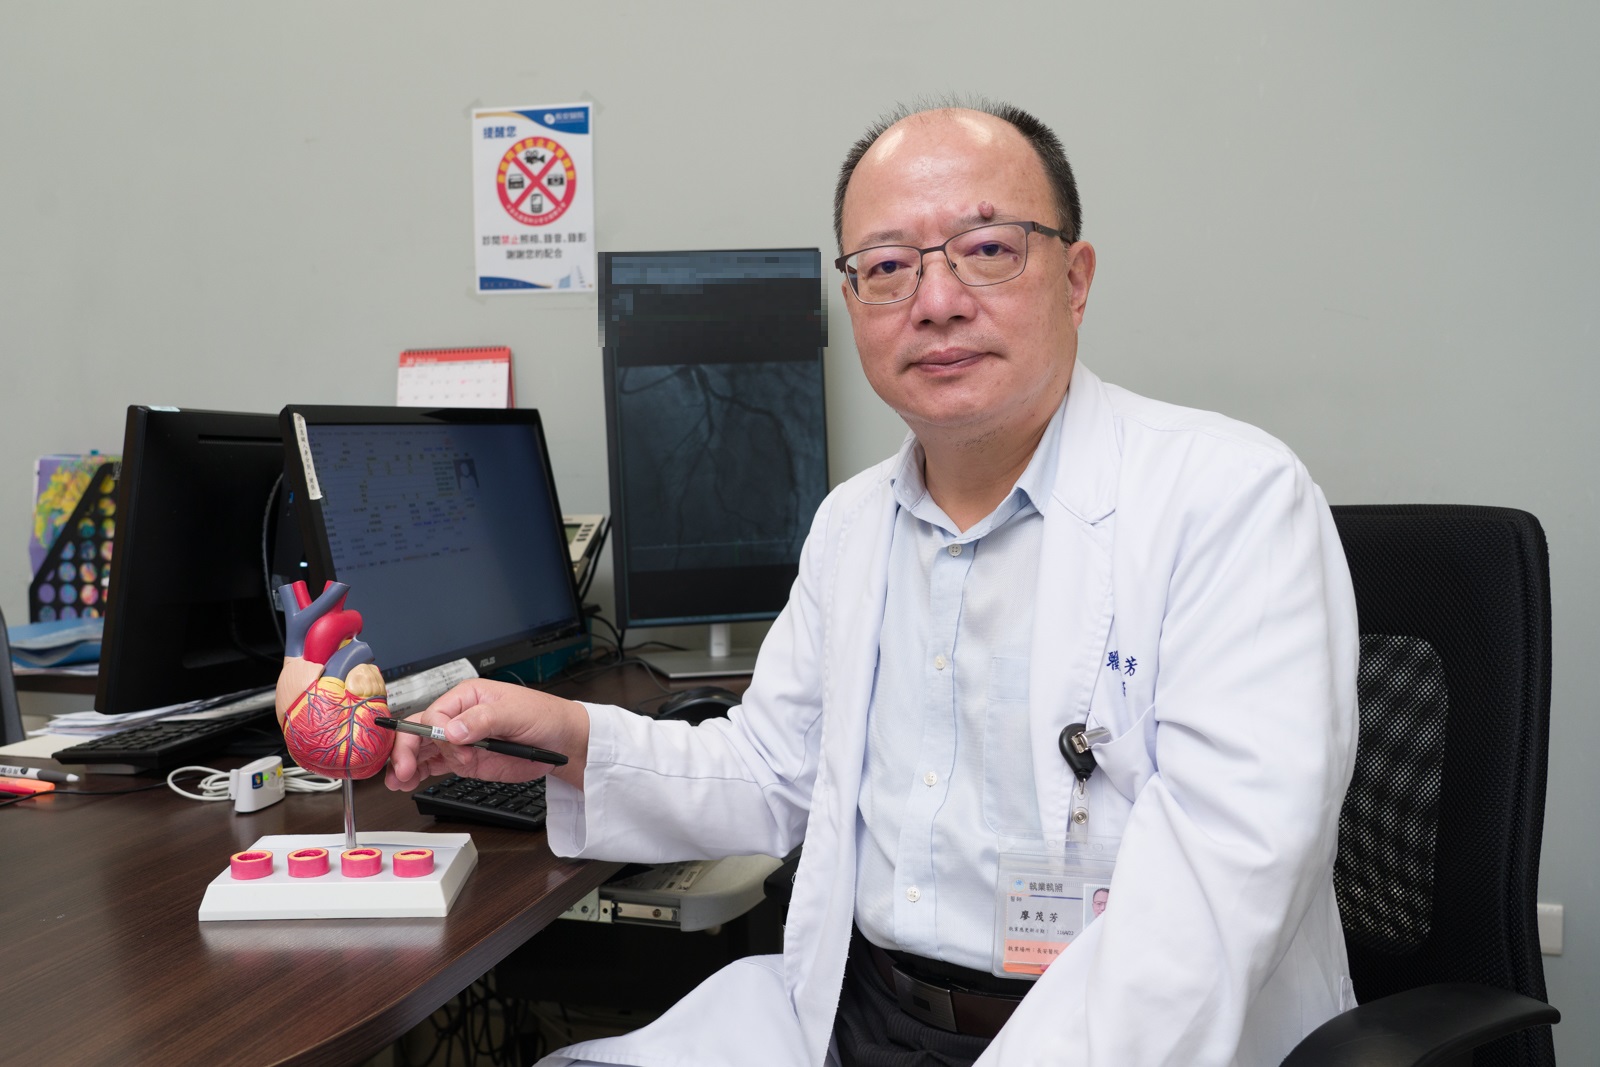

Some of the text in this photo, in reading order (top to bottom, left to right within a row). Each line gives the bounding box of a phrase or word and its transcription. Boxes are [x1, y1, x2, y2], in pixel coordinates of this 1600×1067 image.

[483, 126, 517, 139] 提醒您
[506, 248, 563, 260] 謝謝您的配合
[480, 657, 496, 667] ASUS
[1029, 882, 1063, 893] 執業執照
